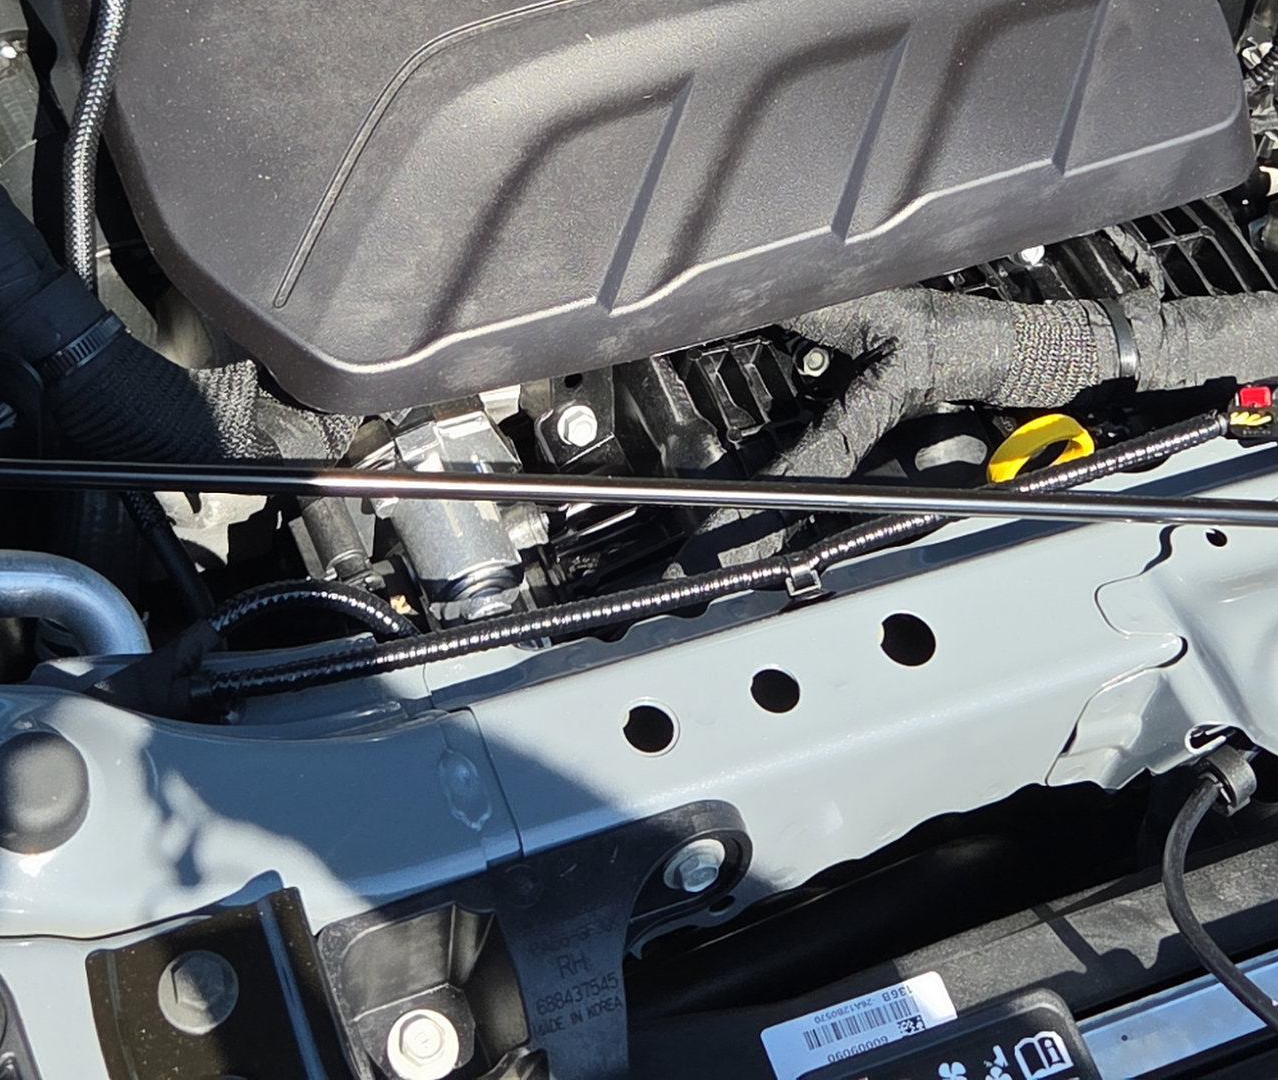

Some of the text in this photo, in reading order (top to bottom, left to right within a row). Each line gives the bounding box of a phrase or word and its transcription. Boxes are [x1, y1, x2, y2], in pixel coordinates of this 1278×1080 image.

[558, 950, 588, 978] RH
[532, 996, 622, 1037] MADE IN KOREA
